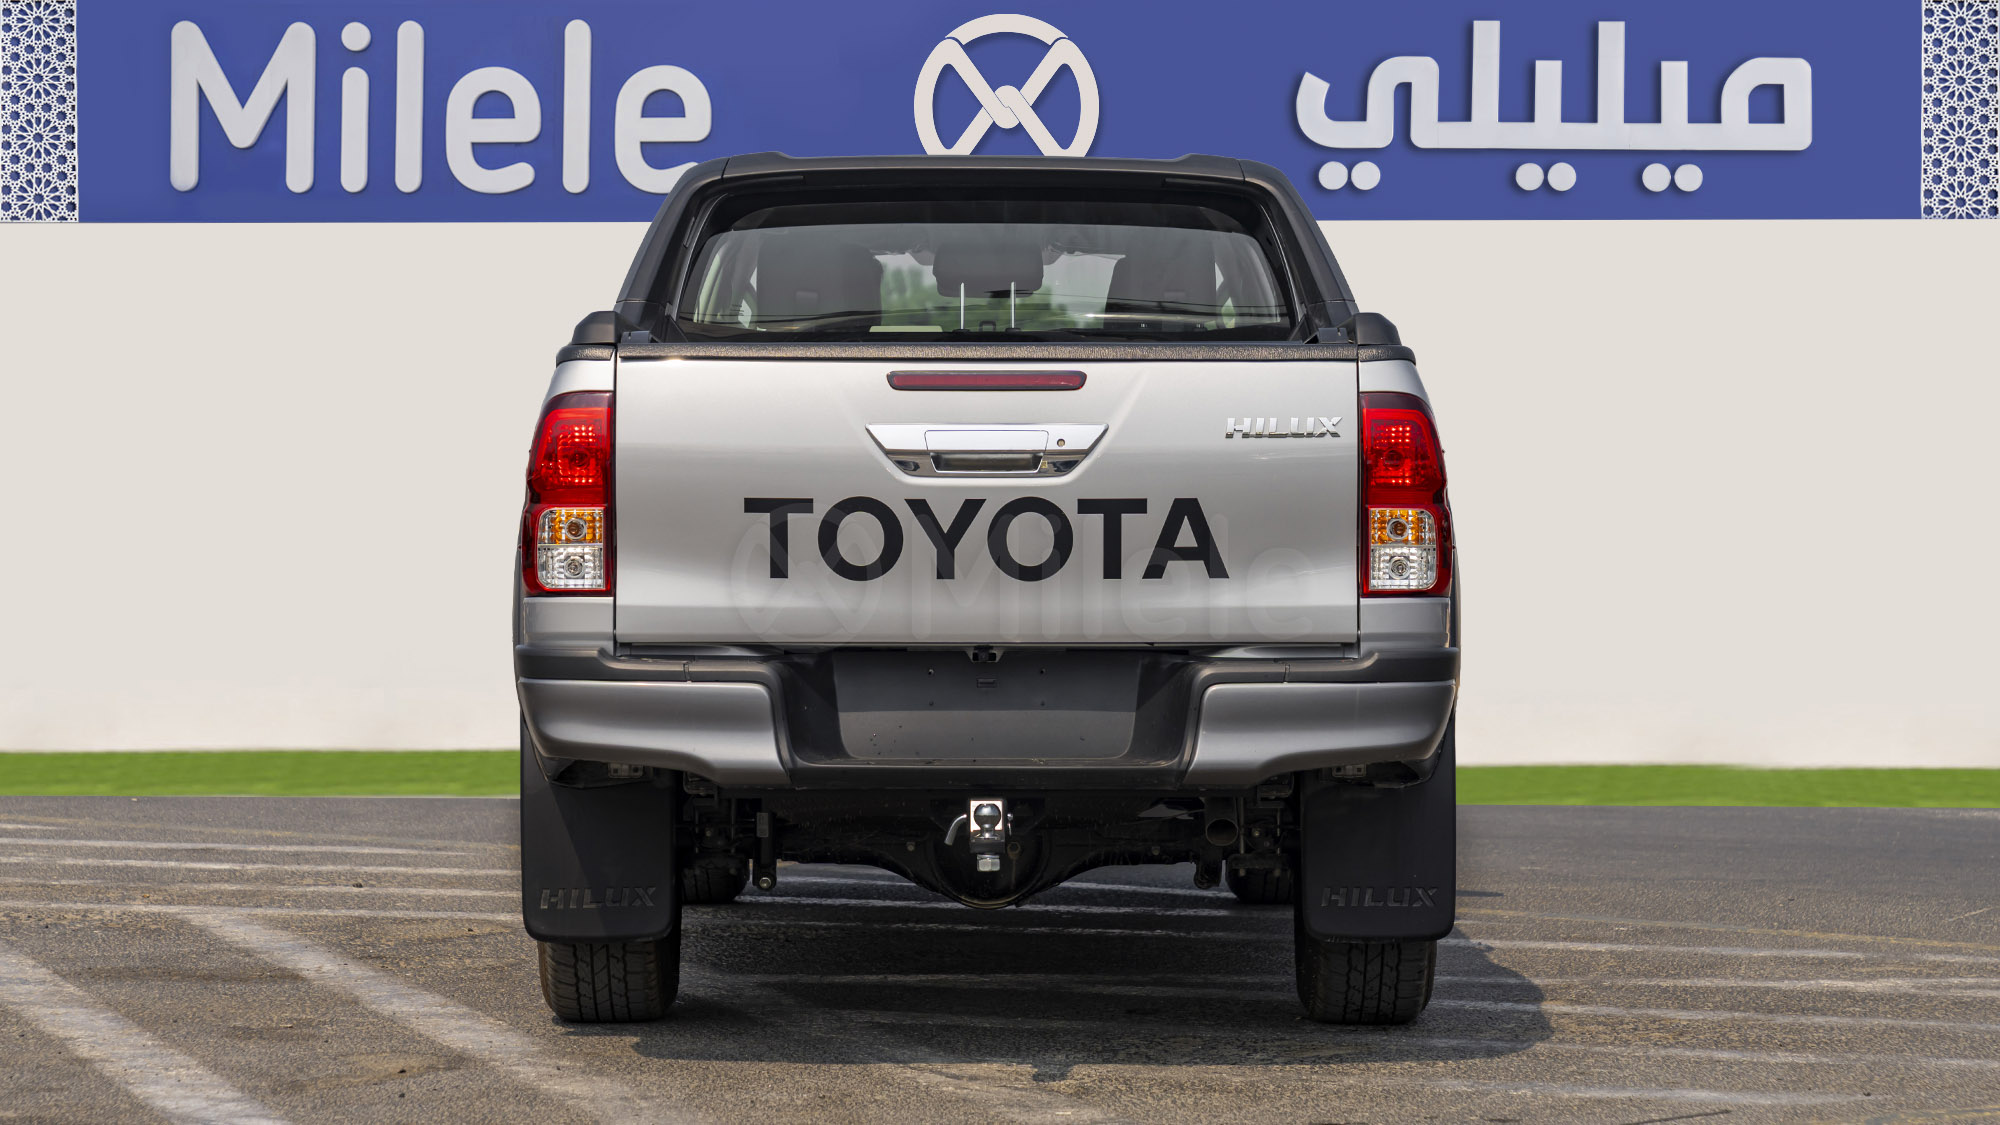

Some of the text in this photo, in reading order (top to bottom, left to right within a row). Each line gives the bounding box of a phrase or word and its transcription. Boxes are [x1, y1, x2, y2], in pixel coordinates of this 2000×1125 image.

[170, 19, 712, 194] Milele
[1296, 20, 1812, 192] ميليلي
[1225, 417, 1343, 438] HILUX
[744, 496, 1230, 582] TOYOTA
[540, 887, 656, 909] HILUX
[1321, 887, 1438, 907] HILUX
